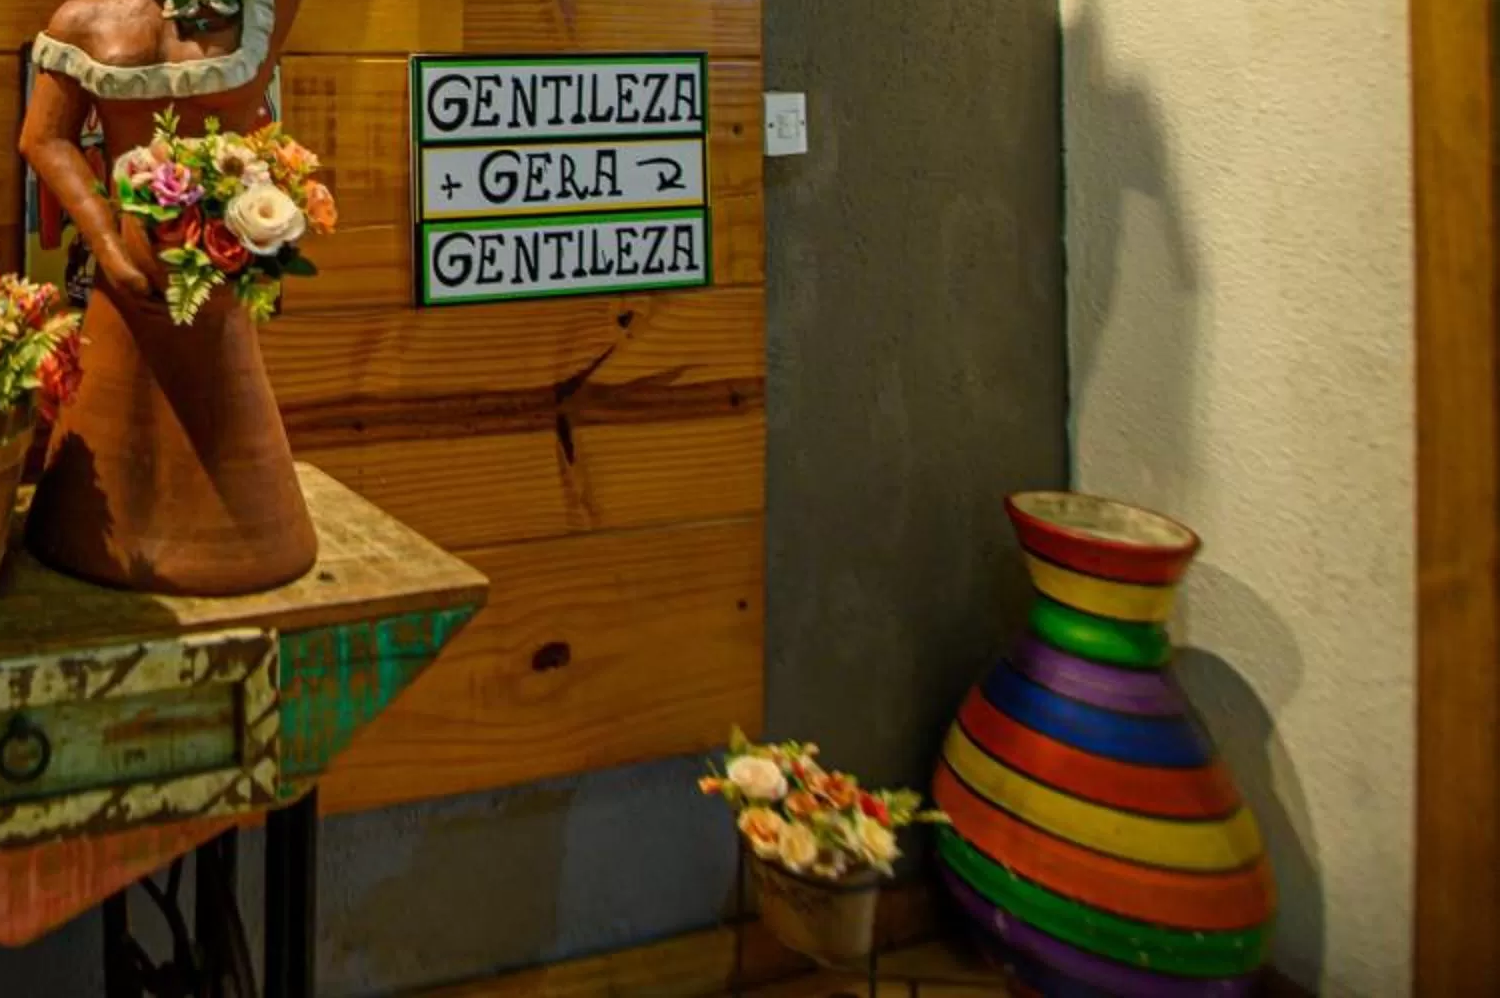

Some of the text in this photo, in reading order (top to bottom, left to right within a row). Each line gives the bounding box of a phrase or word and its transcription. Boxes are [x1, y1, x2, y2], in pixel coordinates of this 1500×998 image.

[427, 73, 702, 132] GENTILEZA
[478, 148, 623, 204] GERA
[432, 224, 700, 287] GENTILEZA
